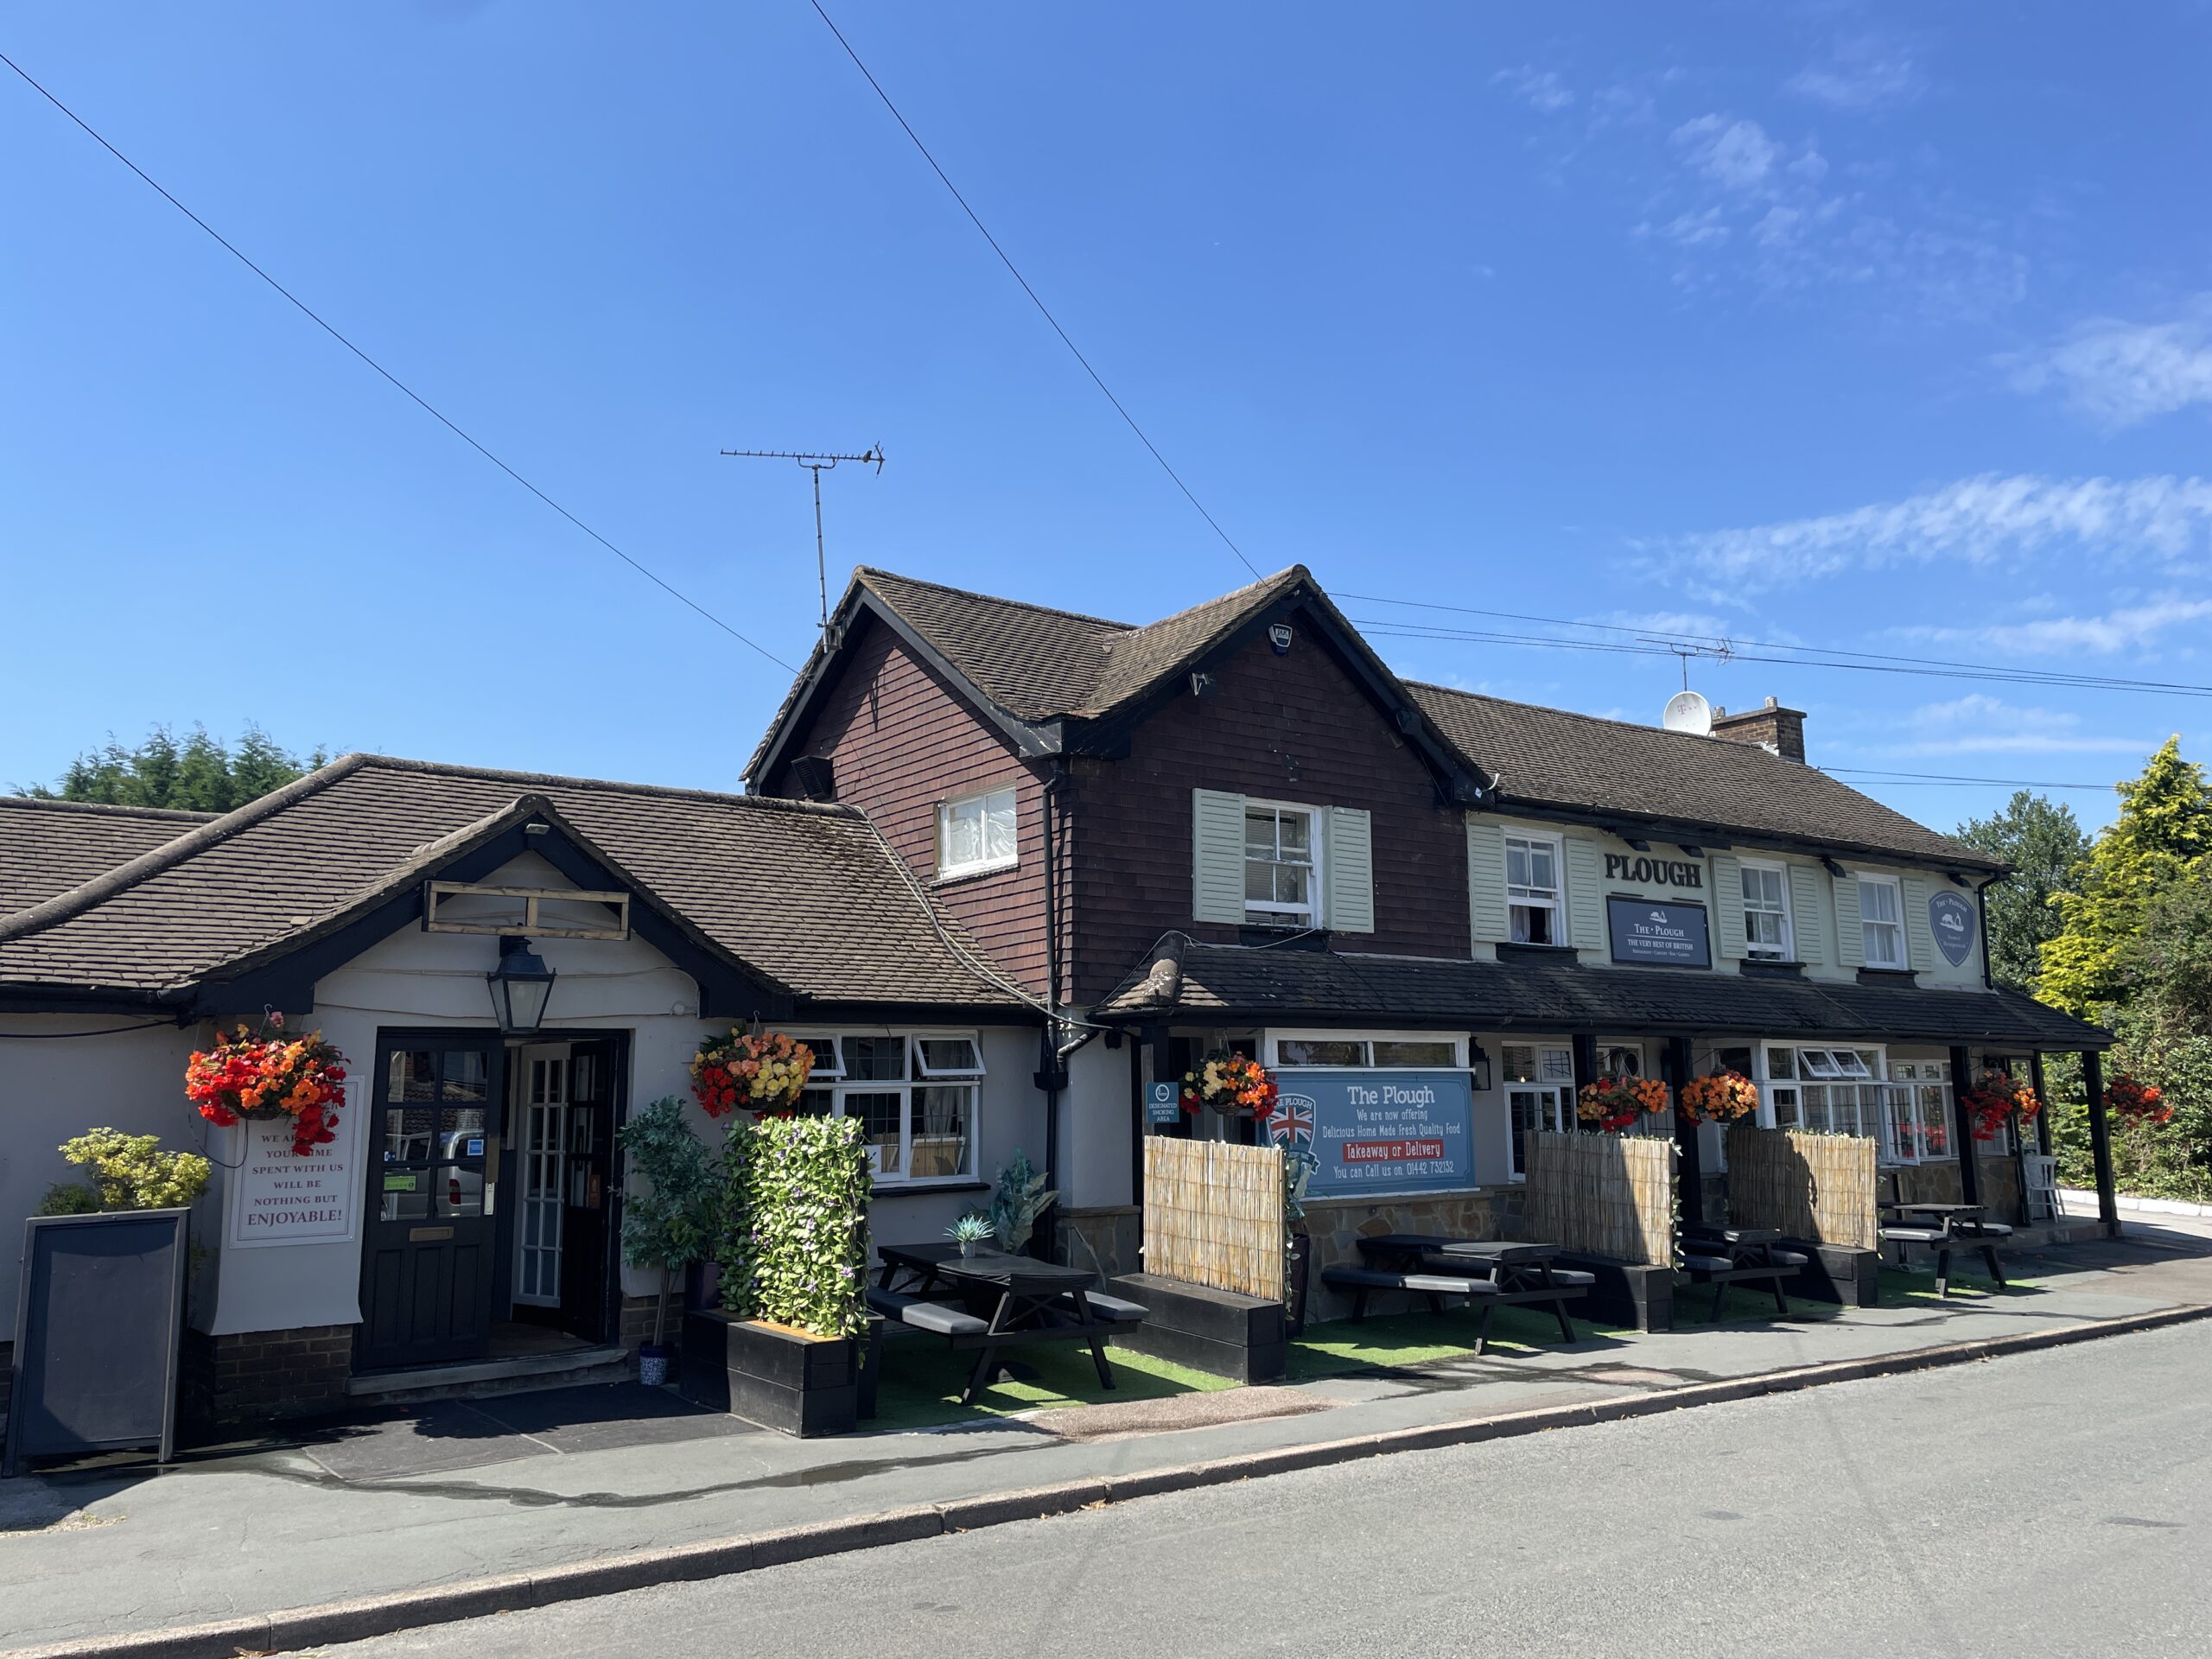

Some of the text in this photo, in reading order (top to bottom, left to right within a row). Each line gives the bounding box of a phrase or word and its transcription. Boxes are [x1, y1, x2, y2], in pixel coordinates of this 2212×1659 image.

[1604, 853, 1703, 888] PLOUGH
[1627, 938, 1639, 947] THE
[1639, 939, 1651, 948] VERY
[1652, 940, 1664, 949] BEST
[1673, 942, 1694, 950] BRITISH
[1285, 1097, 1313, 1109] PLOUGH
[1347, 1085, 1435, 1109] The Plough
[1357, 1109, 1428, 1122] We are now offering
[1322, 1122, 1460, 1139] Delicious Home Made Fresh Quality Food
[261, 1135, 280, 1143] WE
[1346, 1141, 1440, 1160] Takeaway or Delivery
[252, 1165, 291, 1175] SPENT
[294, 1164, 325, 1173] WITH
[1333, 1166, 1347, 1179] You
[1350, 1167, 1363, 1179] can
[1365, 1164, 1380, 1178] Call
[1382, 1166, 1391, 1177] us
[1406, 1161, 1428, 1176] 01442
[1429, 1160, 1455, 1174] 732132
[273, 1180, 303, 1189] WILL
[254, 1194, 338, 1206] NOTHING BUT
[247, 1209, 342, 1227] ENJOYABLE!
